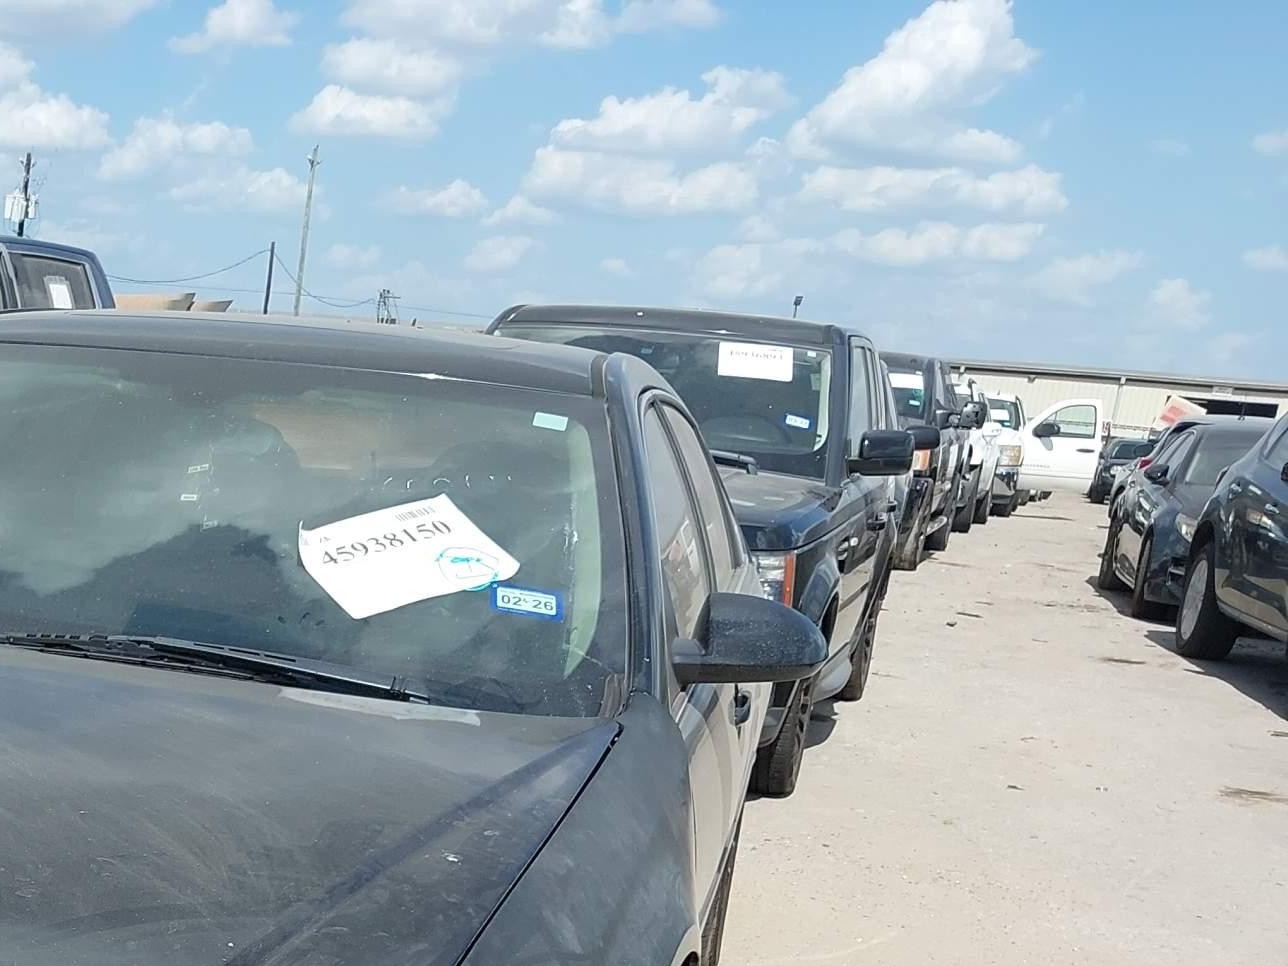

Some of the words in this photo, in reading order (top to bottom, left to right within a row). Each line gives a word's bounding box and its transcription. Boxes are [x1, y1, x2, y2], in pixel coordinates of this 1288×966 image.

[322, 519, 452, 565] 45938150
[501, 594, 522, 607] 02
[531, 599, 555, 611] 26
